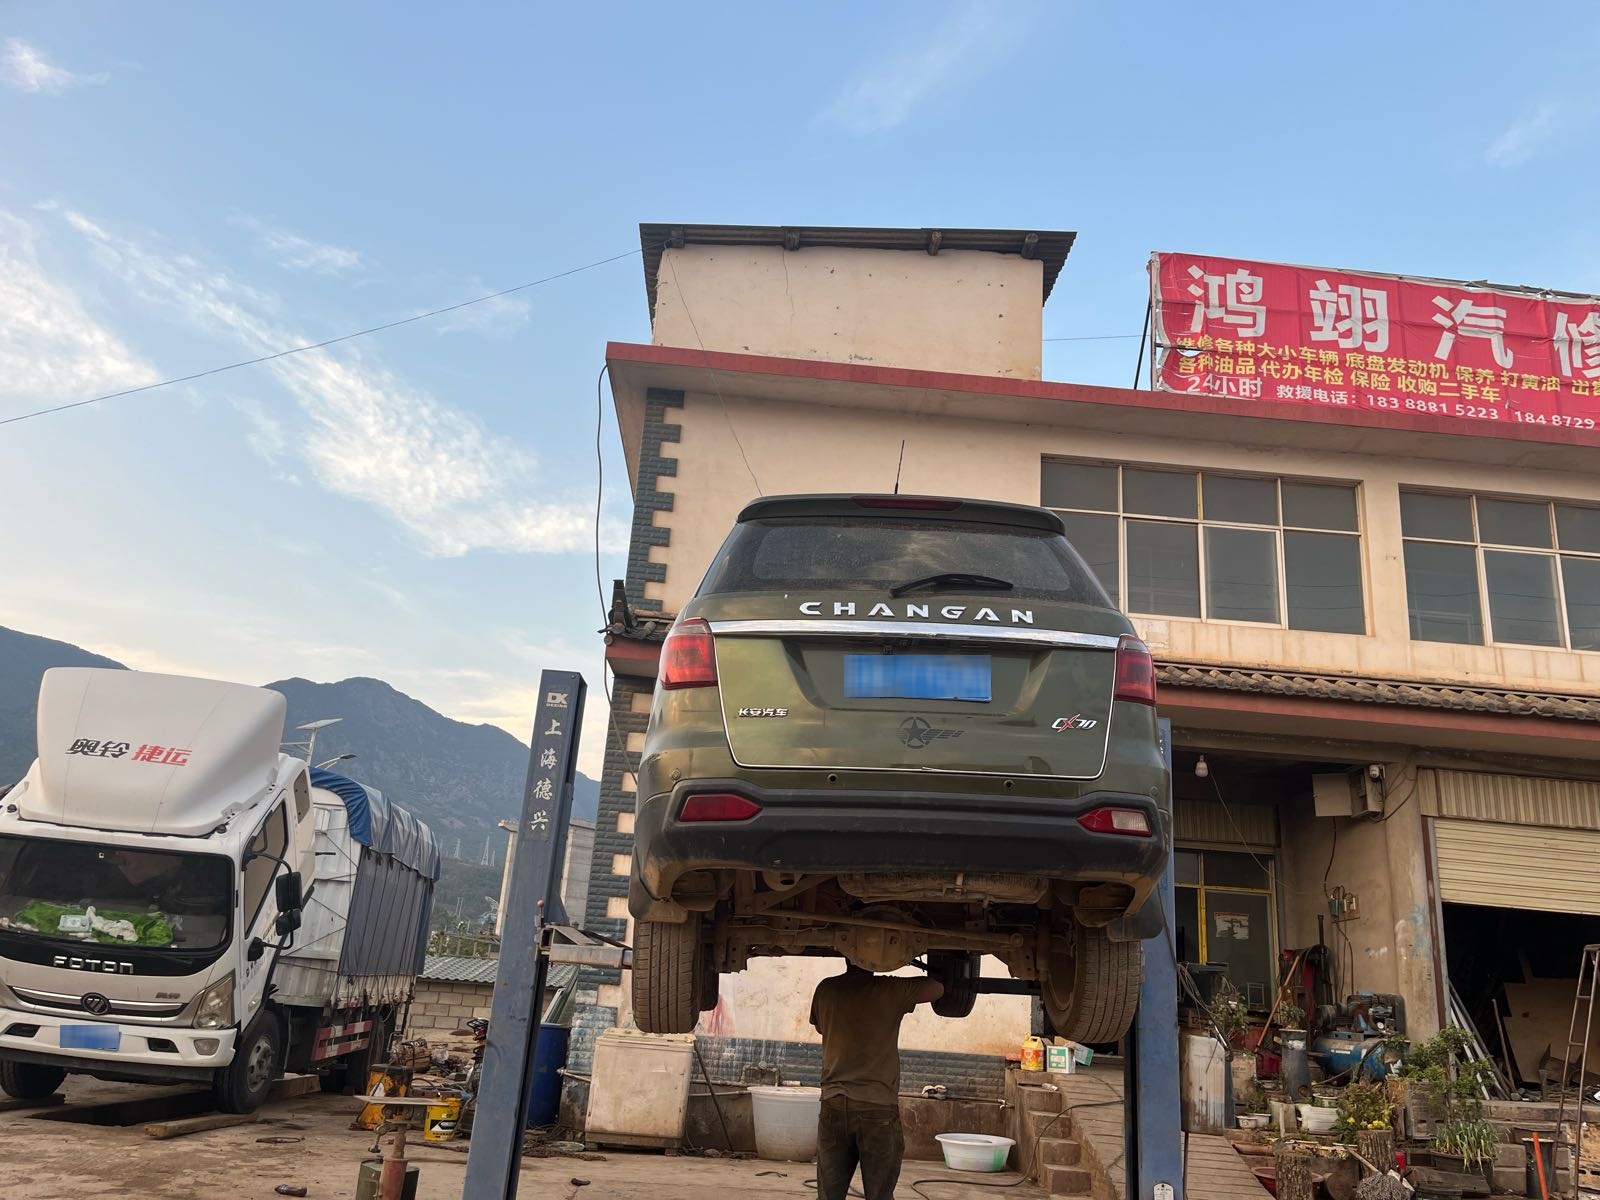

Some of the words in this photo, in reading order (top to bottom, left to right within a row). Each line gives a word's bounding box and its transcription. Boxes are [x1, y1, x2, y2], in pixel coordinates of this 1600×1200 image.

[1176, 334, 1339, 366] 维修各种大小车辆
[1345, 352, 1449, 380] 底盘发动机
[1456, 365, 1495, 386] 保养
[1501, 370, 1560, 391] 打黄油
[1350, 370, 1391, 391] 保险
[1398, 375, 1502, 403] 收购二手车
[1187, 373, 1262, 397] 24小时
[1367, 394, 1399, 410] 183
[1405, 398, 1448, 413] 8881
[1455, 404, 1499, 420] 5223
[1515, 410, 1547, 426] 184
[1551, 414, 1595, 429] 8729
[799, 601, 1034, 625] CHANGAN
[738, 707, 788, 718] 长安汽车
[1051, 713, 1099, 734] CX70
[530, 719, 562, 831] 上海德兴
[53, 955, 134, 974] FOTON
